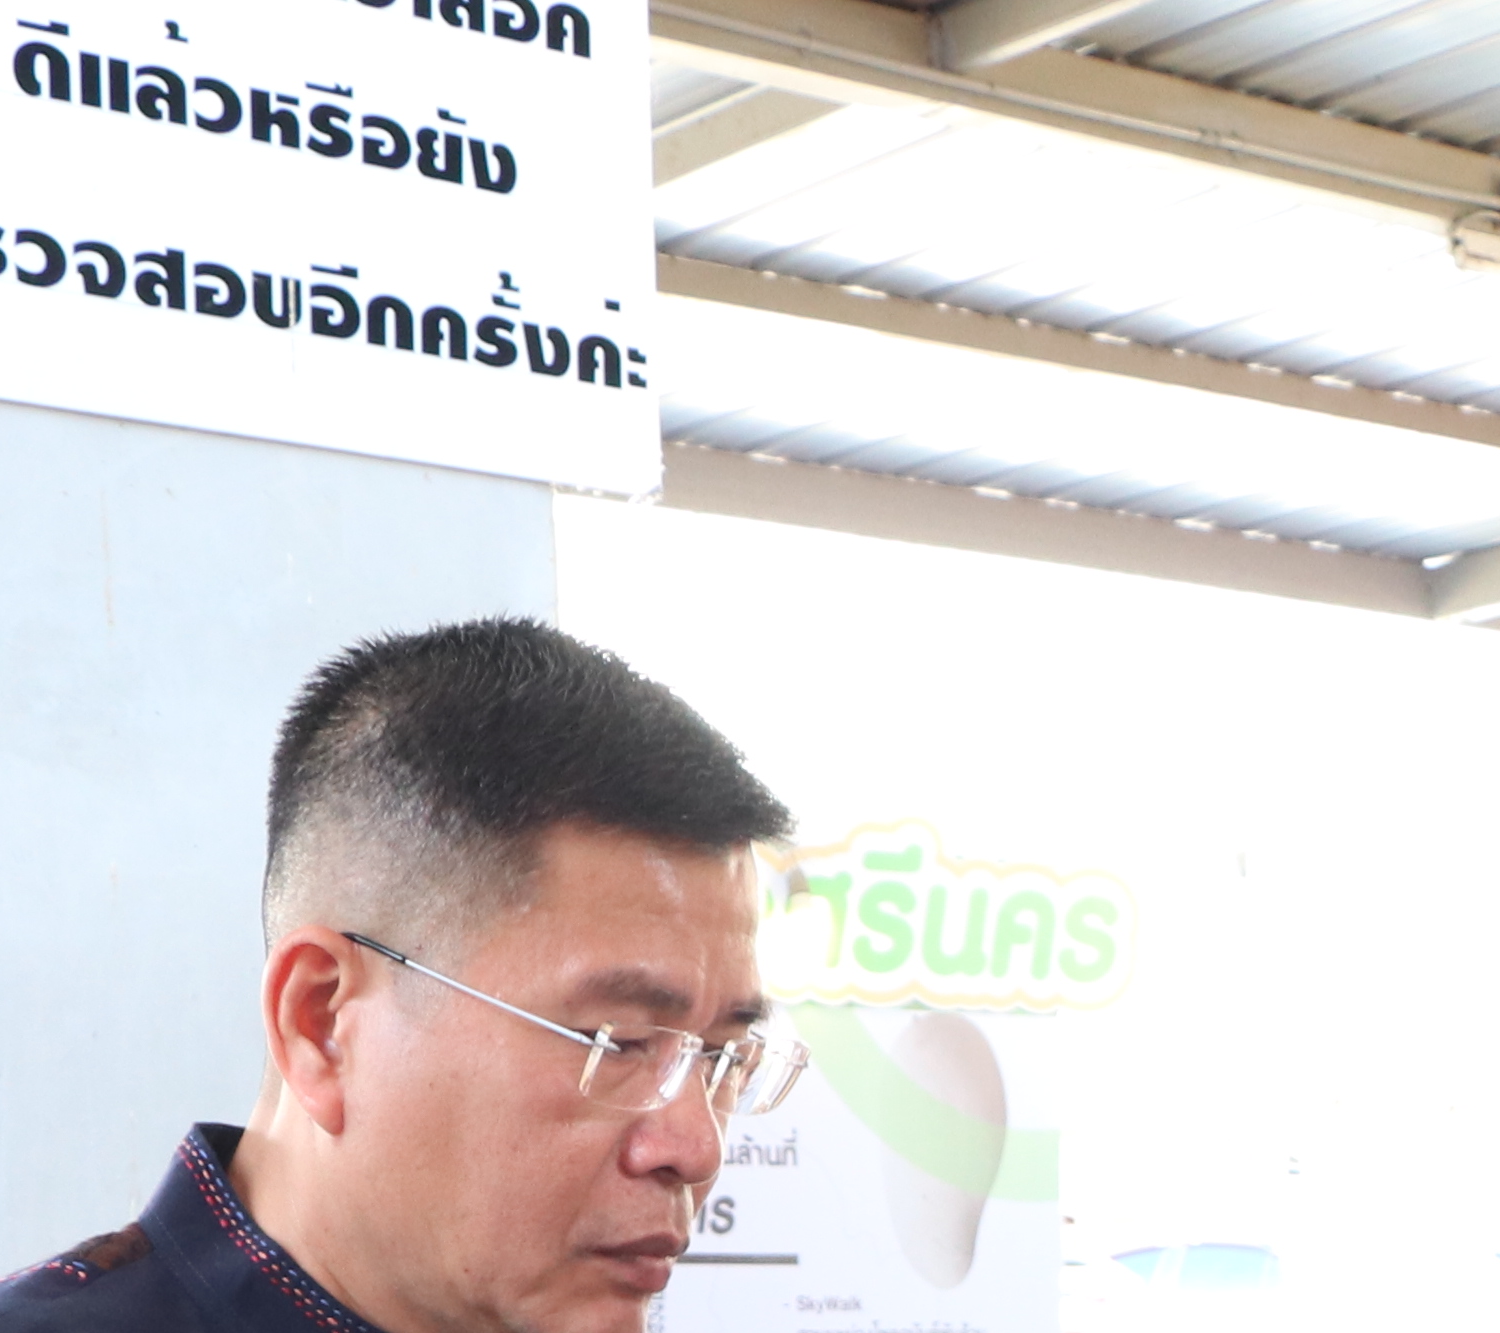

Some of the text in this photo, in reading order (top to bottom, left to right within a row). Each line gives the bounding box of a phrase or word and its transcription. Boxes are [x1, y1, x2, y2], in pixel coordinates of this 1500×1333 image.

[13, 20, 517, 194] ดีแล้วหรือยัง
